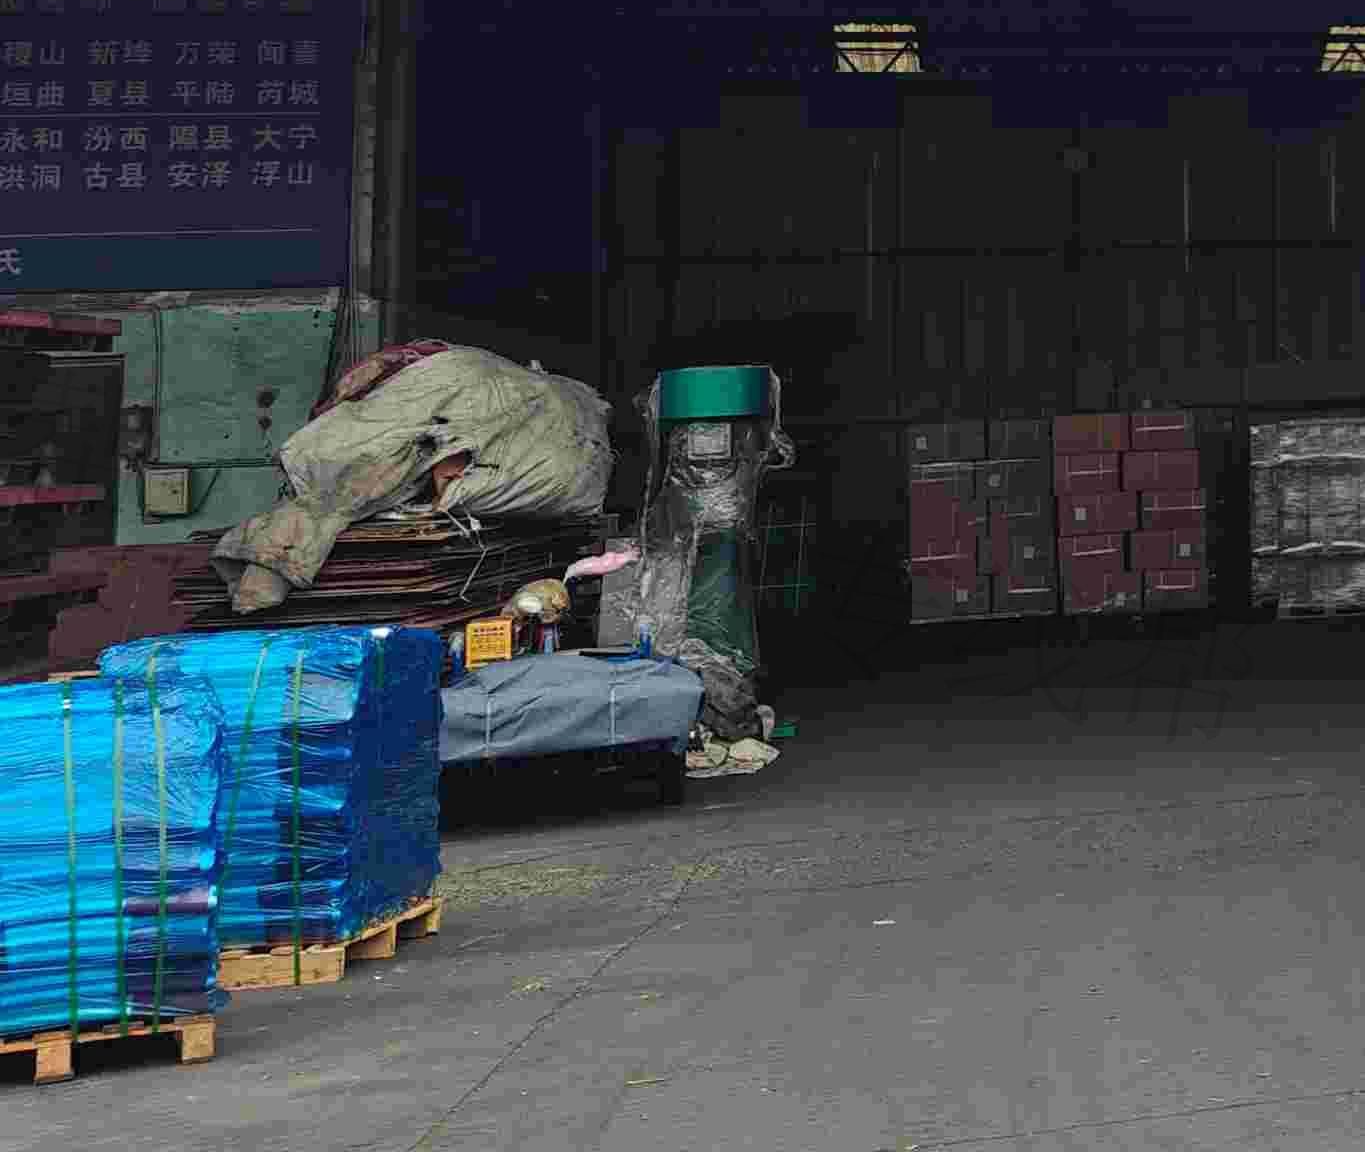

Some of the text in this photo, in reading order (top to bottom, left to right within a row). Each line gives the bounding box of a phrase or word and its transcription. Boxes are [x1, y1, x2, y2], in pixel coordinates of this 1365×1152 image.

[88, 80, 151, 106] 夏县
[171, 79, 235, 106] 平陆
[84, 125, 149, 152] 汾西
[252, 122, 317, 152] 大宁
[83, 161, 147, 189] 古县
[167, 160, 232, 189] 安泽
[251, 159, 314, 186] 浮山
